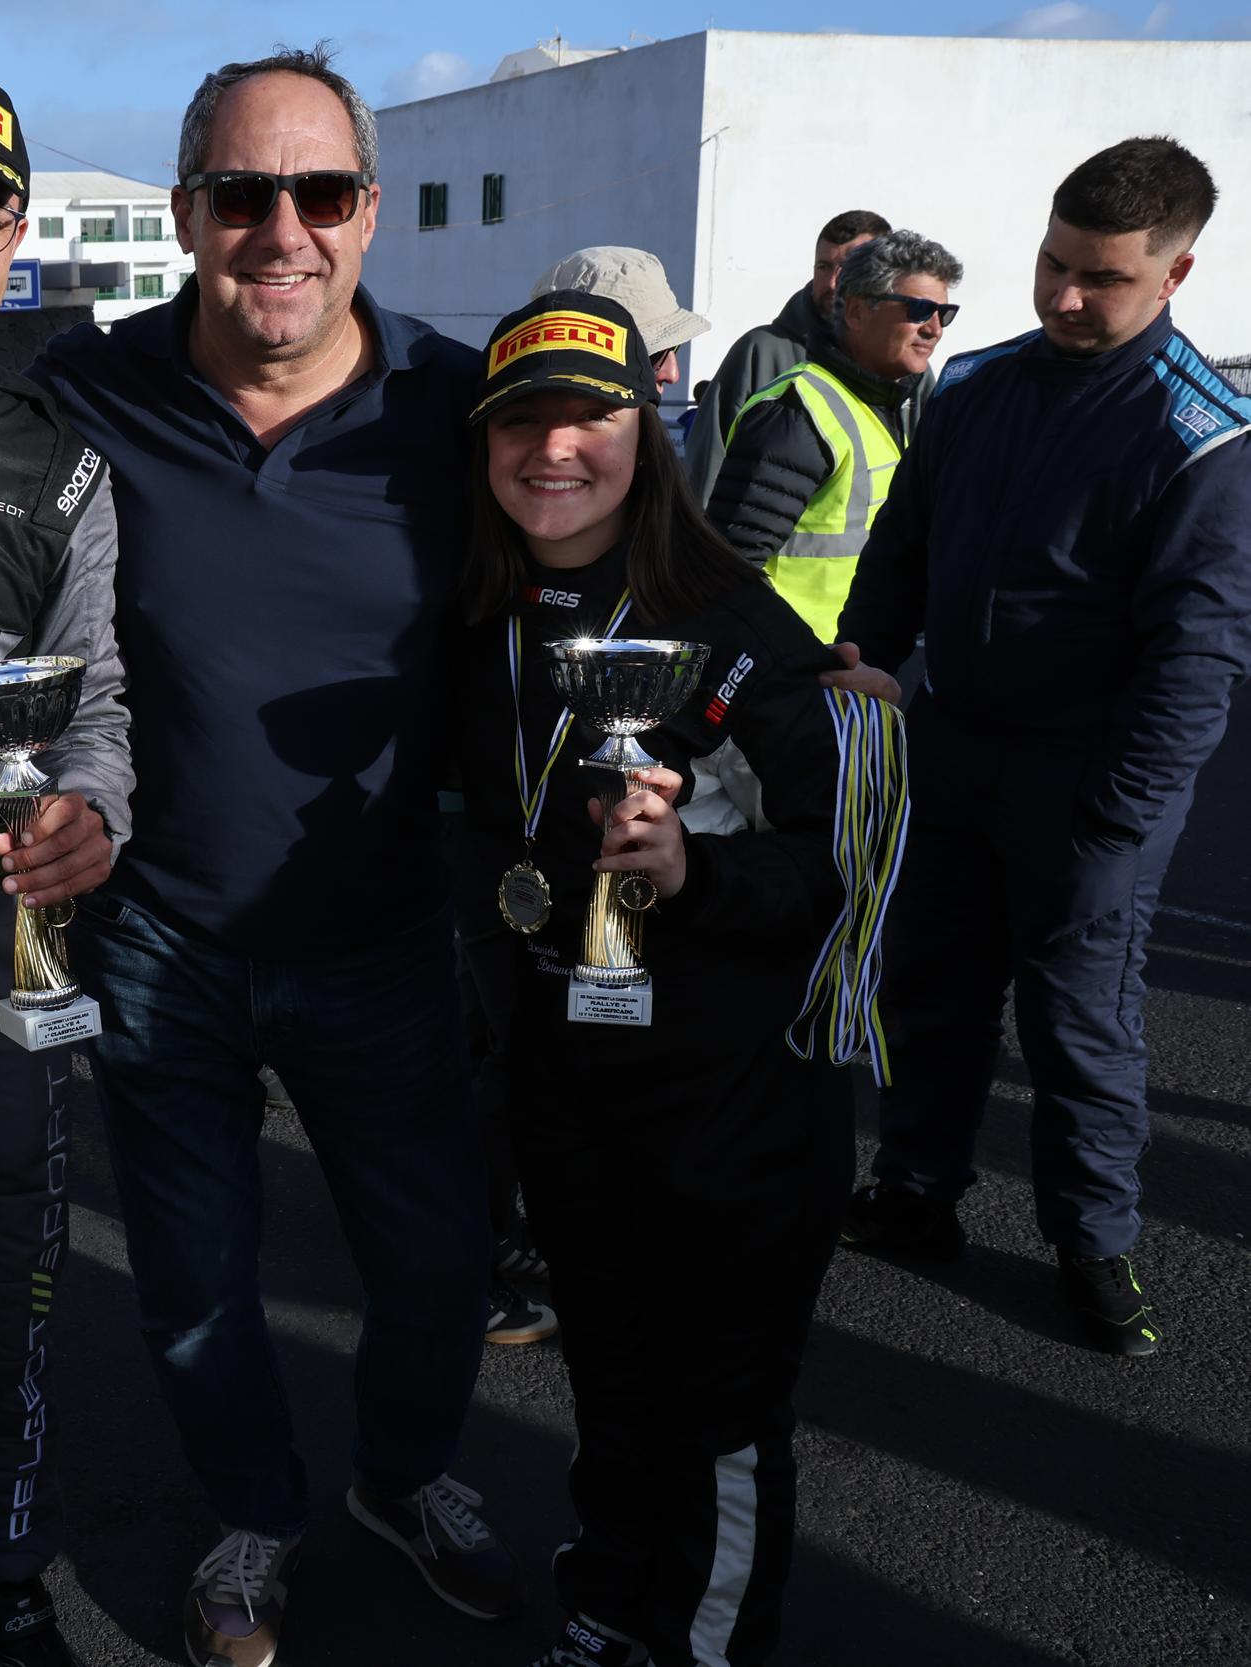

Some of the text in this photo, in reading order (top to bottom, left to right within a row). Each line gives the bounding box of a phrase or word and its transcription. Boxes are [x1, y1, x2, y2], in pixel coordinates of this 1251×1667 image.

[495, 317, 616, 366] PIRELLI
[1179, 407, 1217, 432] OMP
[57, 448, 100, 516] sparco
[539, 588, 582, 608] RRS
[717, 652, 755, 704] RRS
[592, 1007, 634, 1015] CLASIFICADO
[48, 1021, 75, 1031] RALLYE
[50, 1024, 87, 1037] CLASIFICADO
[59, 1032, 77, 1040] FEBRERO
[566, 1620, 607, 1653] RRS
